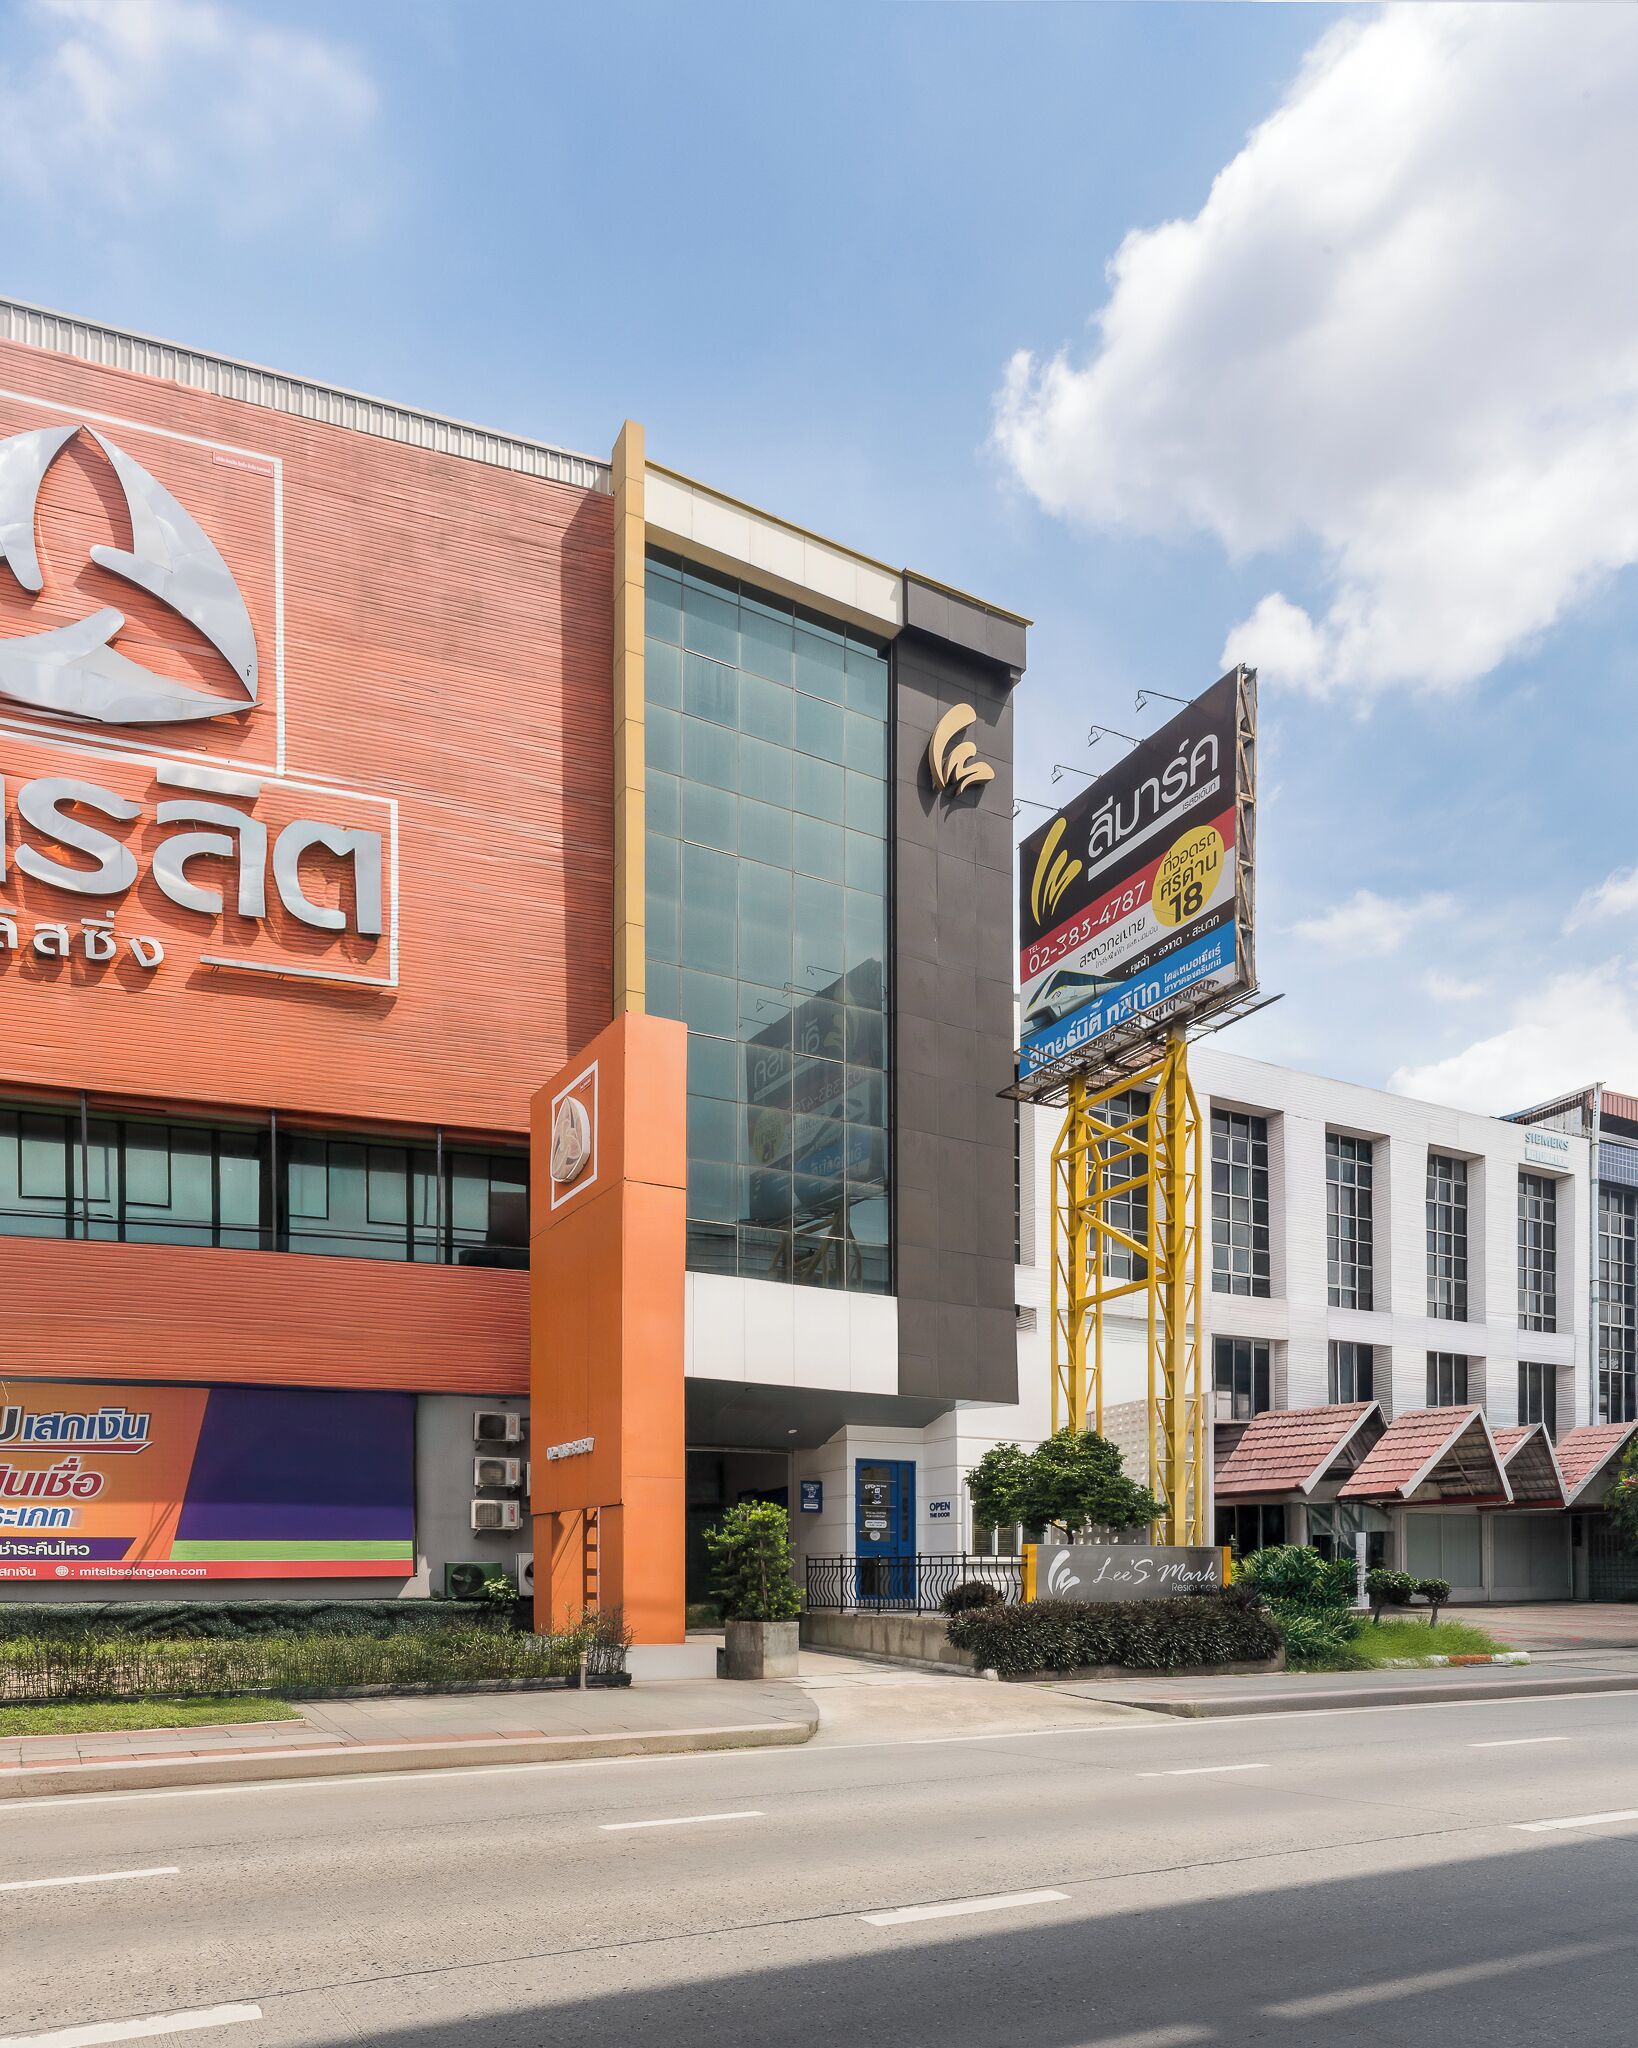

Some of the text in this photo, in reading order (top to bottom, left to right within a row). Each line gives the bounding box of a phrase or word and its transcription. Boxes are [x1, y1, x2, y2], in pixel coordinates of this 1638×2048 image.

[1088, 734, 1219, 858] ลีมาร์ค
[1163, 831, 1216, 876] ที่จอดรถ
[1160, 850, 1217, 901] ศรีด่าน
[1169, 881, 1203, 924] 18
[1525, 1132, 1569, 1152] SIEMENS
[0, 1455, 105, 1500] นเชื่อ
[0, 1506, 72, 1529] ะเภท
[929, 1501, 951, 1511] OPEN
[79, 1567, 207, 1578] mitsibsekngoen.com
[1157, 1561, 1218, 1583] Mark
